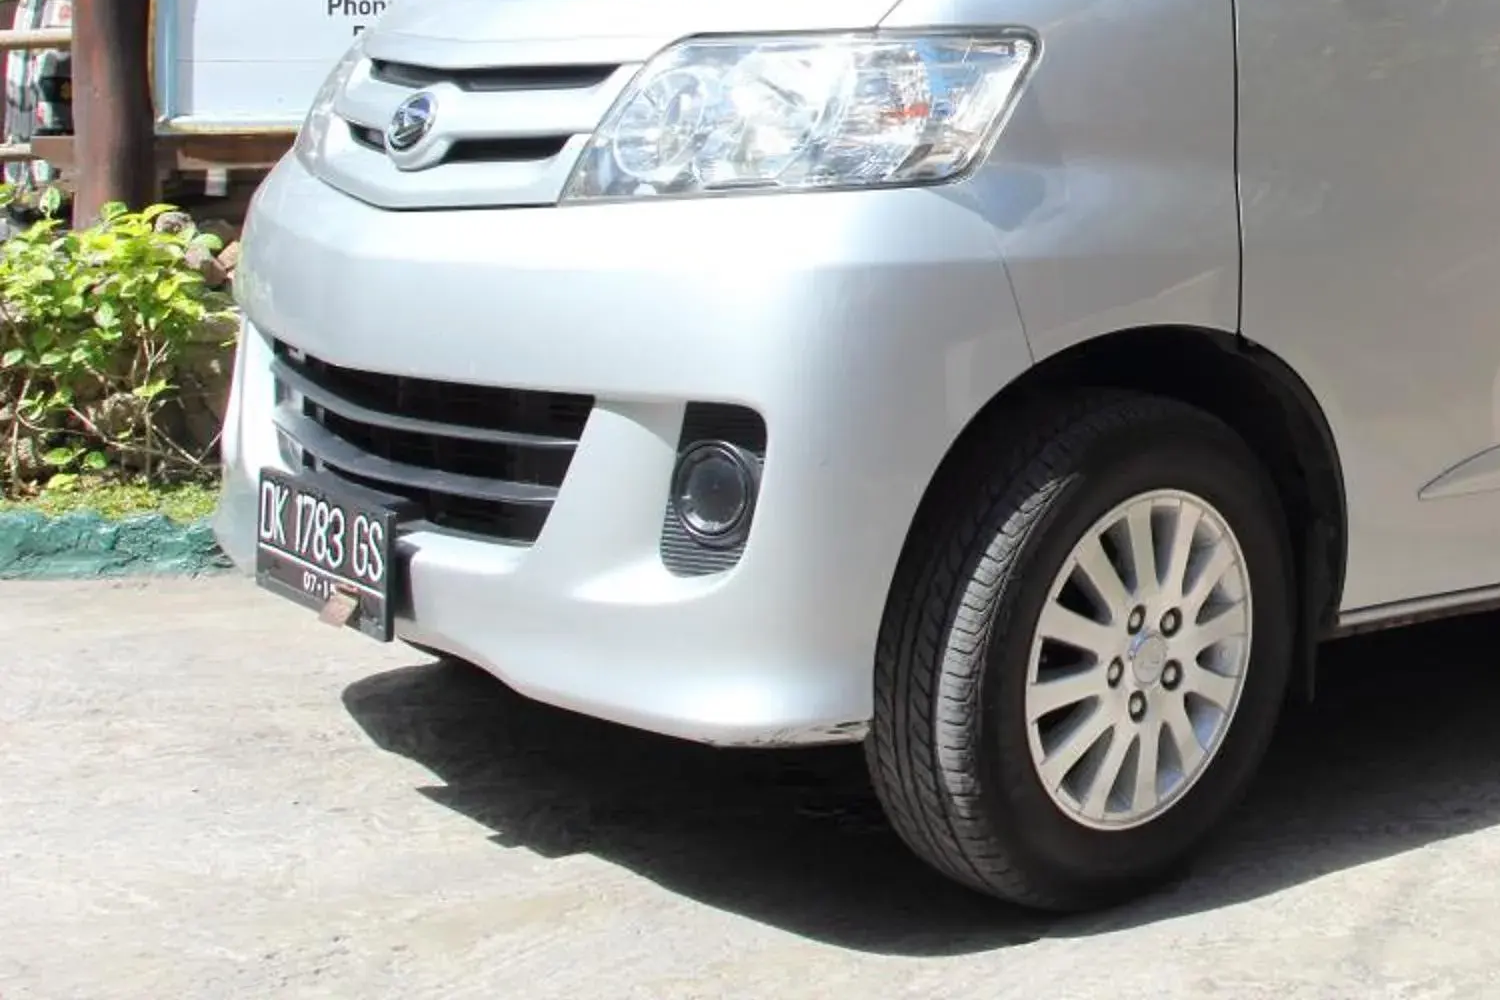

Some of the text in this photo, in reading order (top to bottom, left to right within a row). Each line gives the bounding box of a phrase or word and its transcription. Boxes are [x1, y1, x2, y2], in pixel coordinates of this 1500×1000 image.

[260, 480, 384, 582] DK 1783 GS
